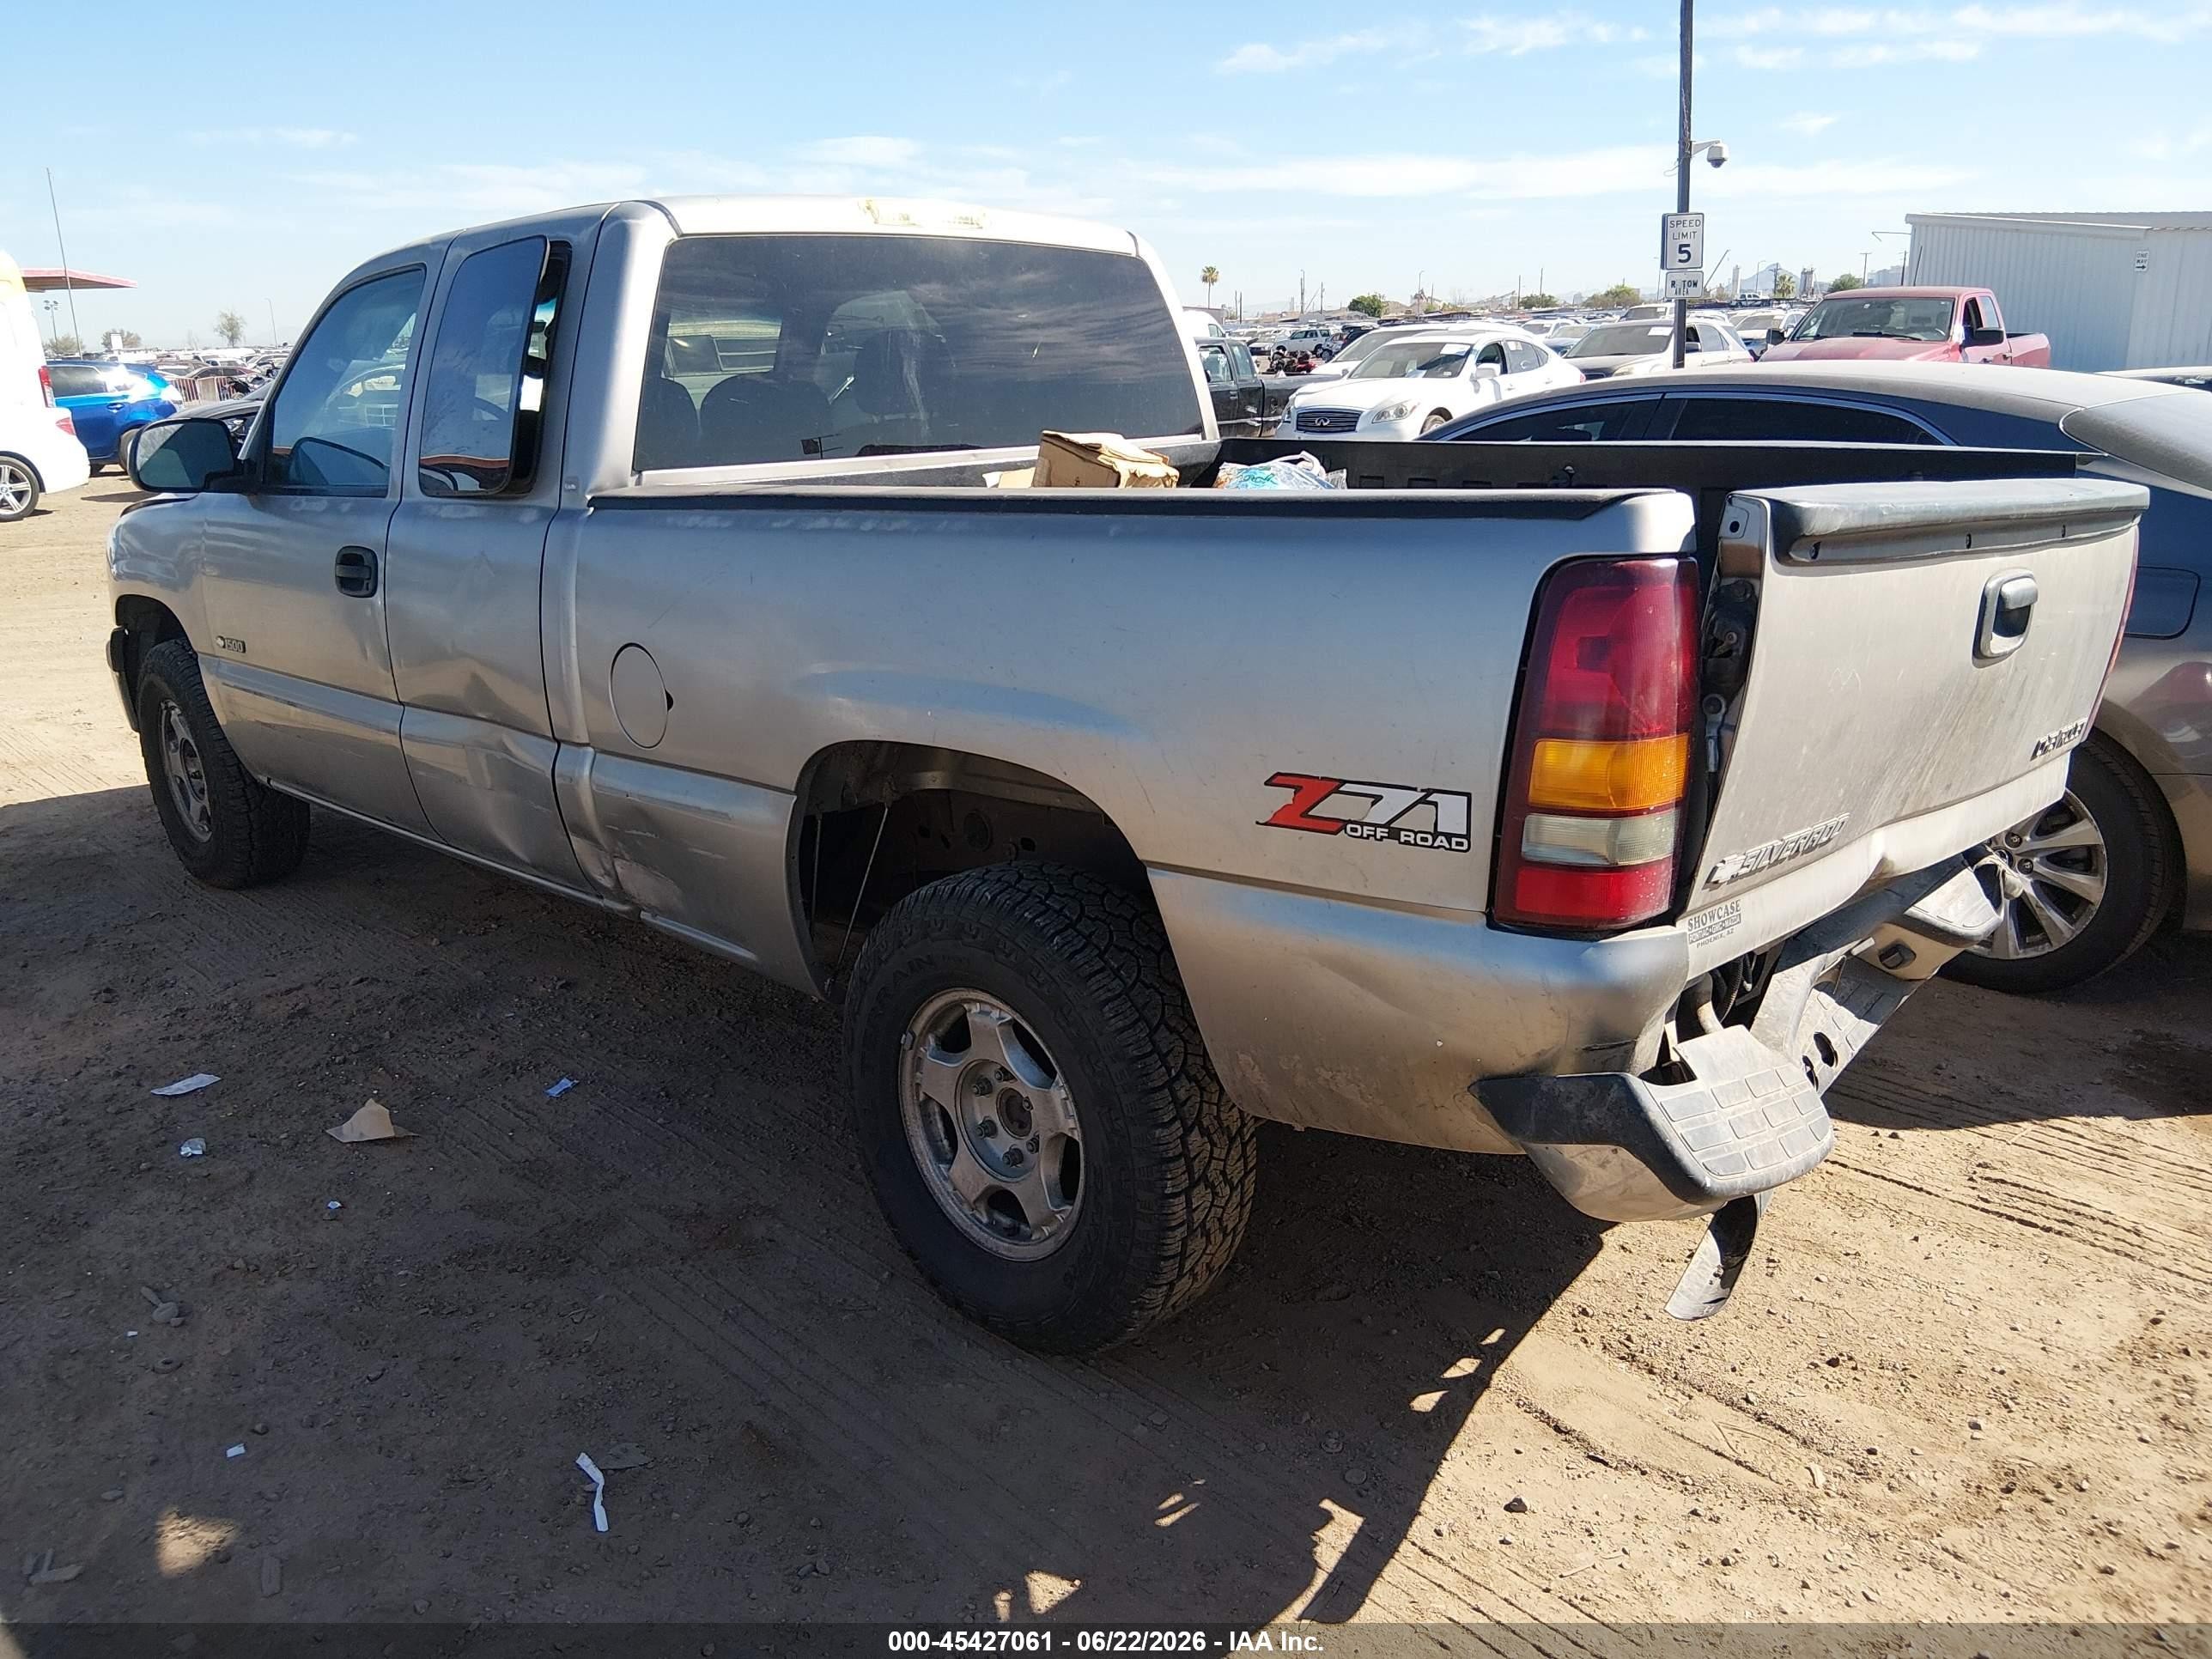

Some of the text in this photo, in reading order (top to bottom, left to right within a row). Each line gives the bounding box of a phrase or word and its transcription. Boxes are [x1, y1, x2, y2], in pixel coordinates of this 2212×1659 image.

[1669, 219, 1701, 228] SPEED
[1673, 231, 1698, 240] LIMIT
[1678, 244, 1692, 264] 5
[1681, 279, 1698, 289] TOW
[225, 639, 243, 653] 1500
[1255, 771, 1472, 836] Z71
[1345, 823, 1471, 853] OFF ROAD
[1740, 812, 1850, 875] SILVERADO
[1688, 899, 1741, 932] SHOWCASE
[1696, 932, 1725, 948] PHOENIX,
